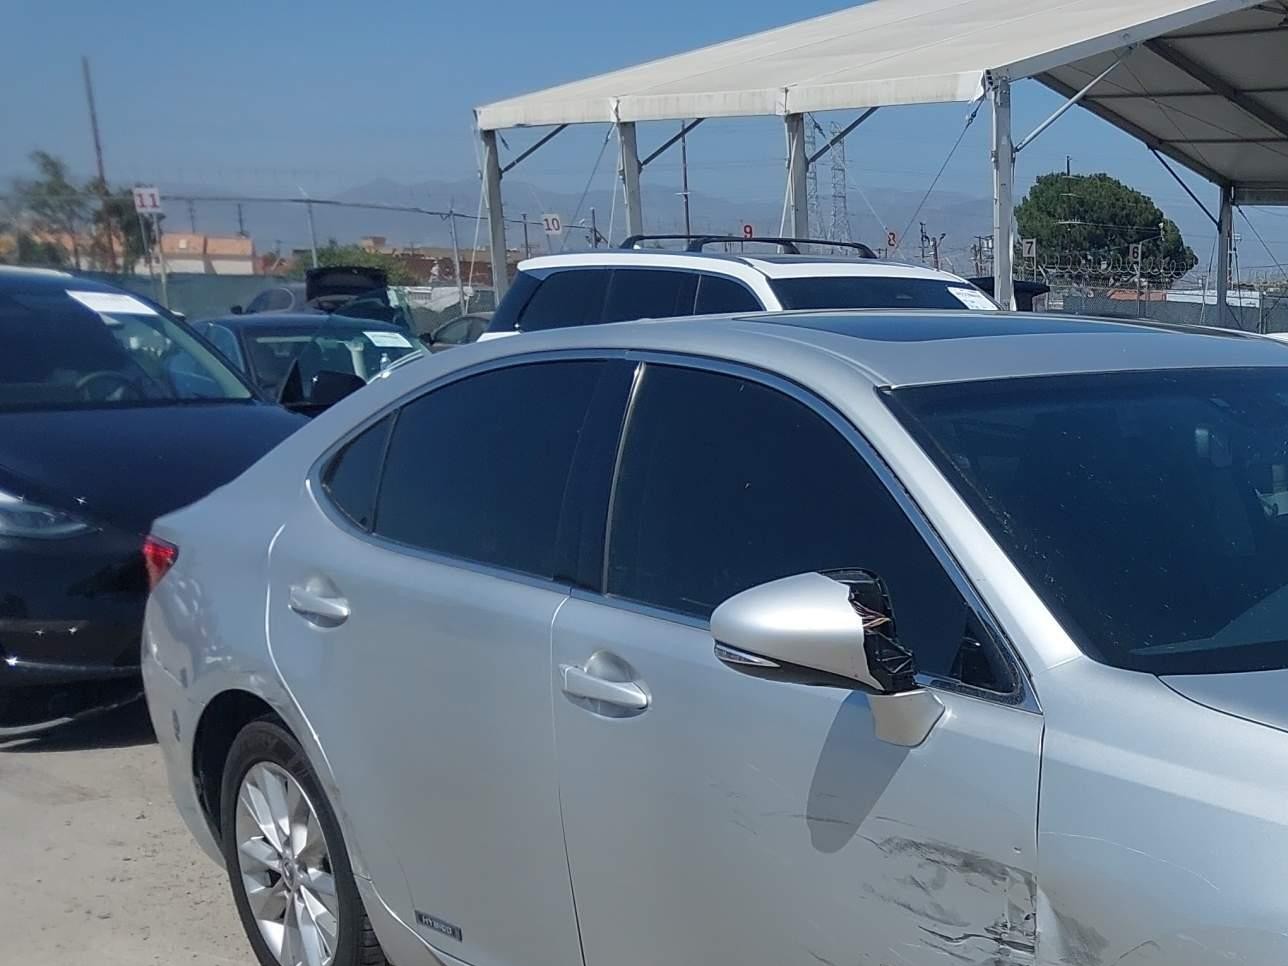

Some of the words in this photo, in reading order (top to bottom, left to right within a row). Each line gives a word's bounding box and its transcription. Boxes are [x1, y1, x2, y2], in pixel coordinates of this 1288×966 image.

[137, 193, 160, 208] 11
[543, 217, 561, 231] 10
[743, 224, 753, 239] 9
[1025, 241, 1034, 255] 7
[1132, 246, 1139, 259] 6
